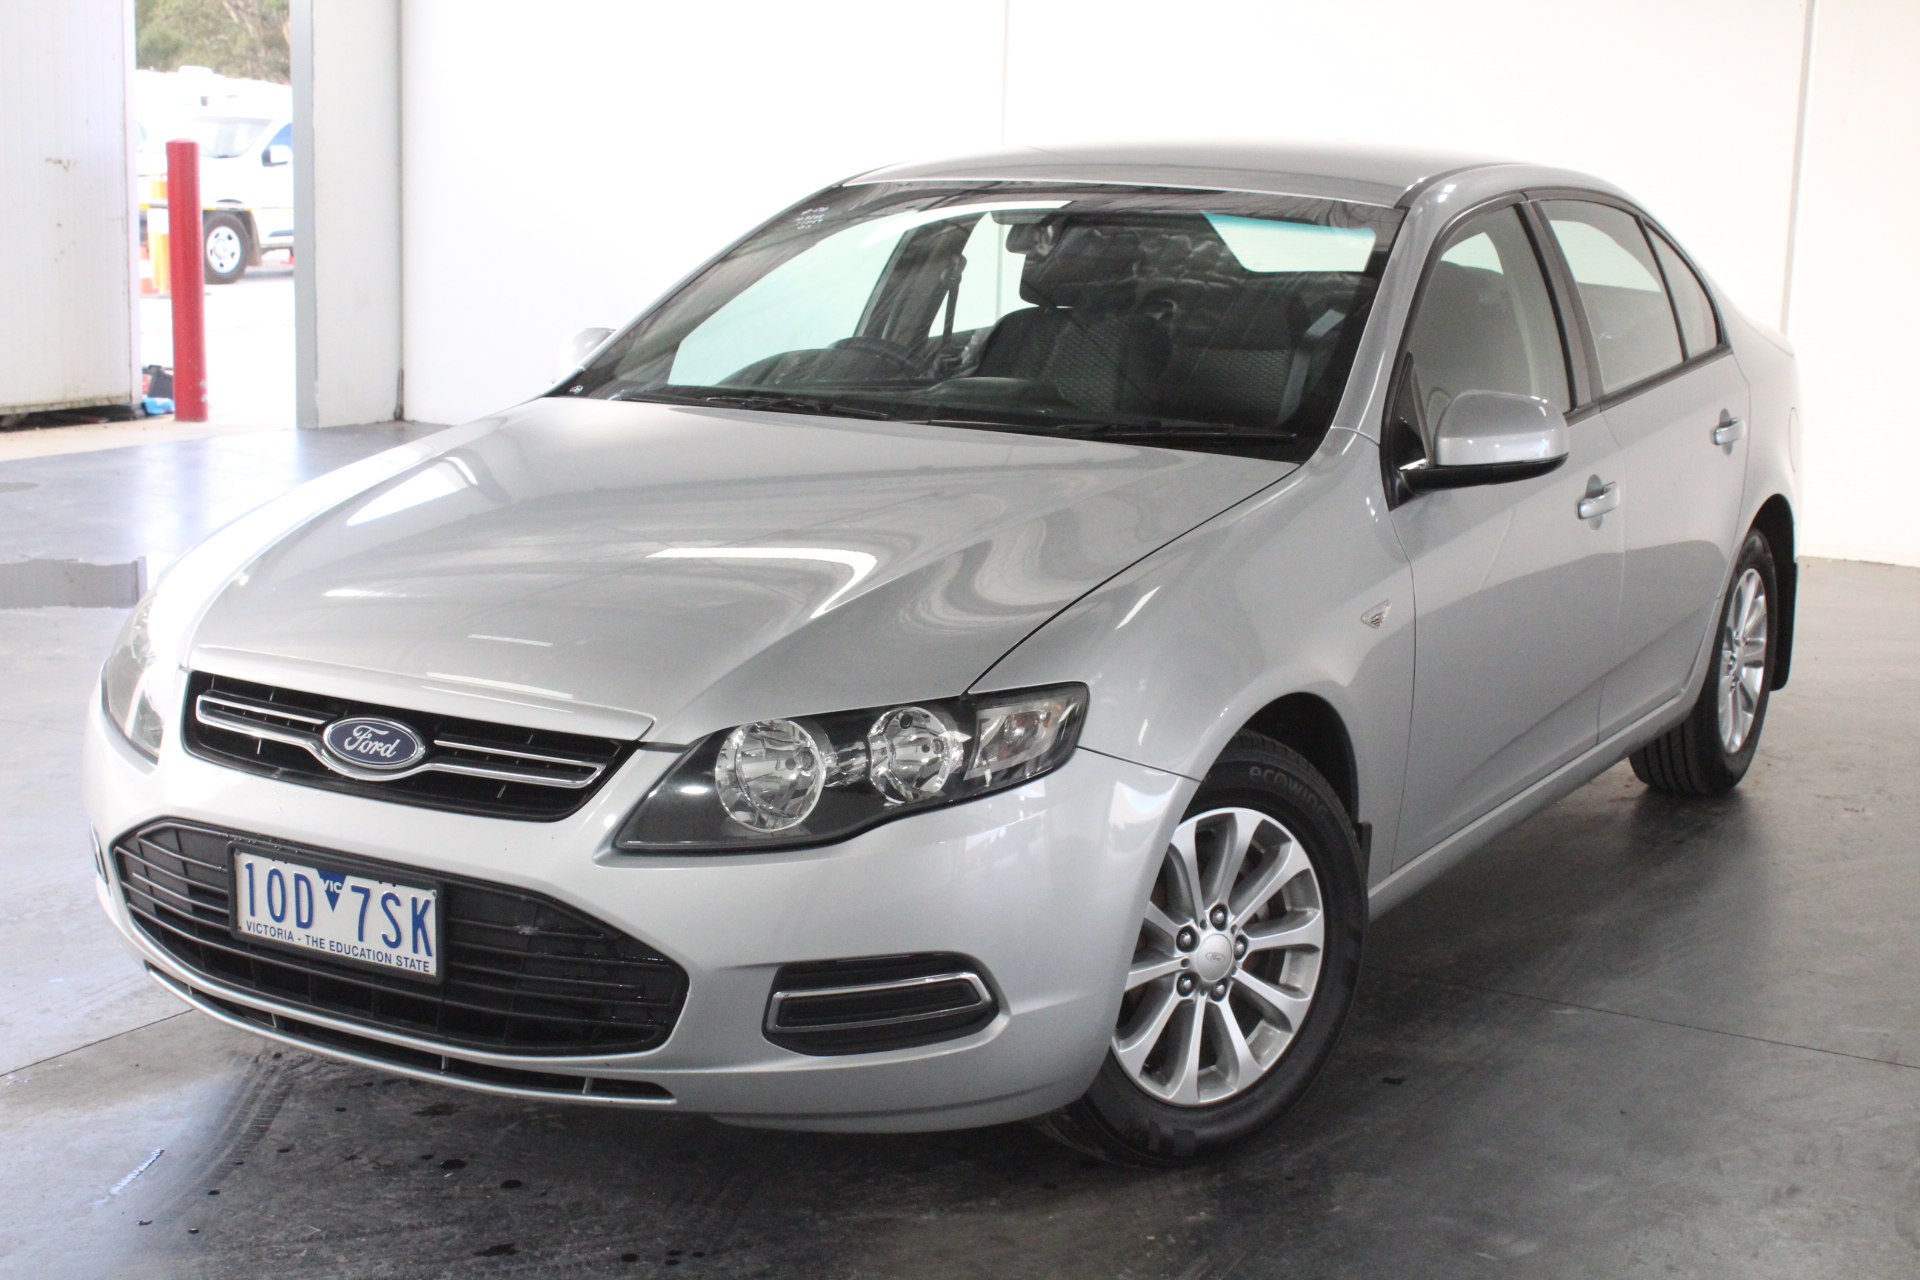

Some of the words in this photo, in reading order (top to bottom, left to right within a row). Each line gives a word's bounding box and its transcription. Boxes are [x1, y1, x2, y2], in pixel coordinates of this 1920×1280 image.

[344, 725, 401, 758] Ford
[322, 879, 343, 894] VIC
[246, 920, 295, 942] VICTORIA
[305, 935, 326, 950] THE
[329, 940, 392, 965] EDUCATION
[396, 955, 430, 973] STATE
